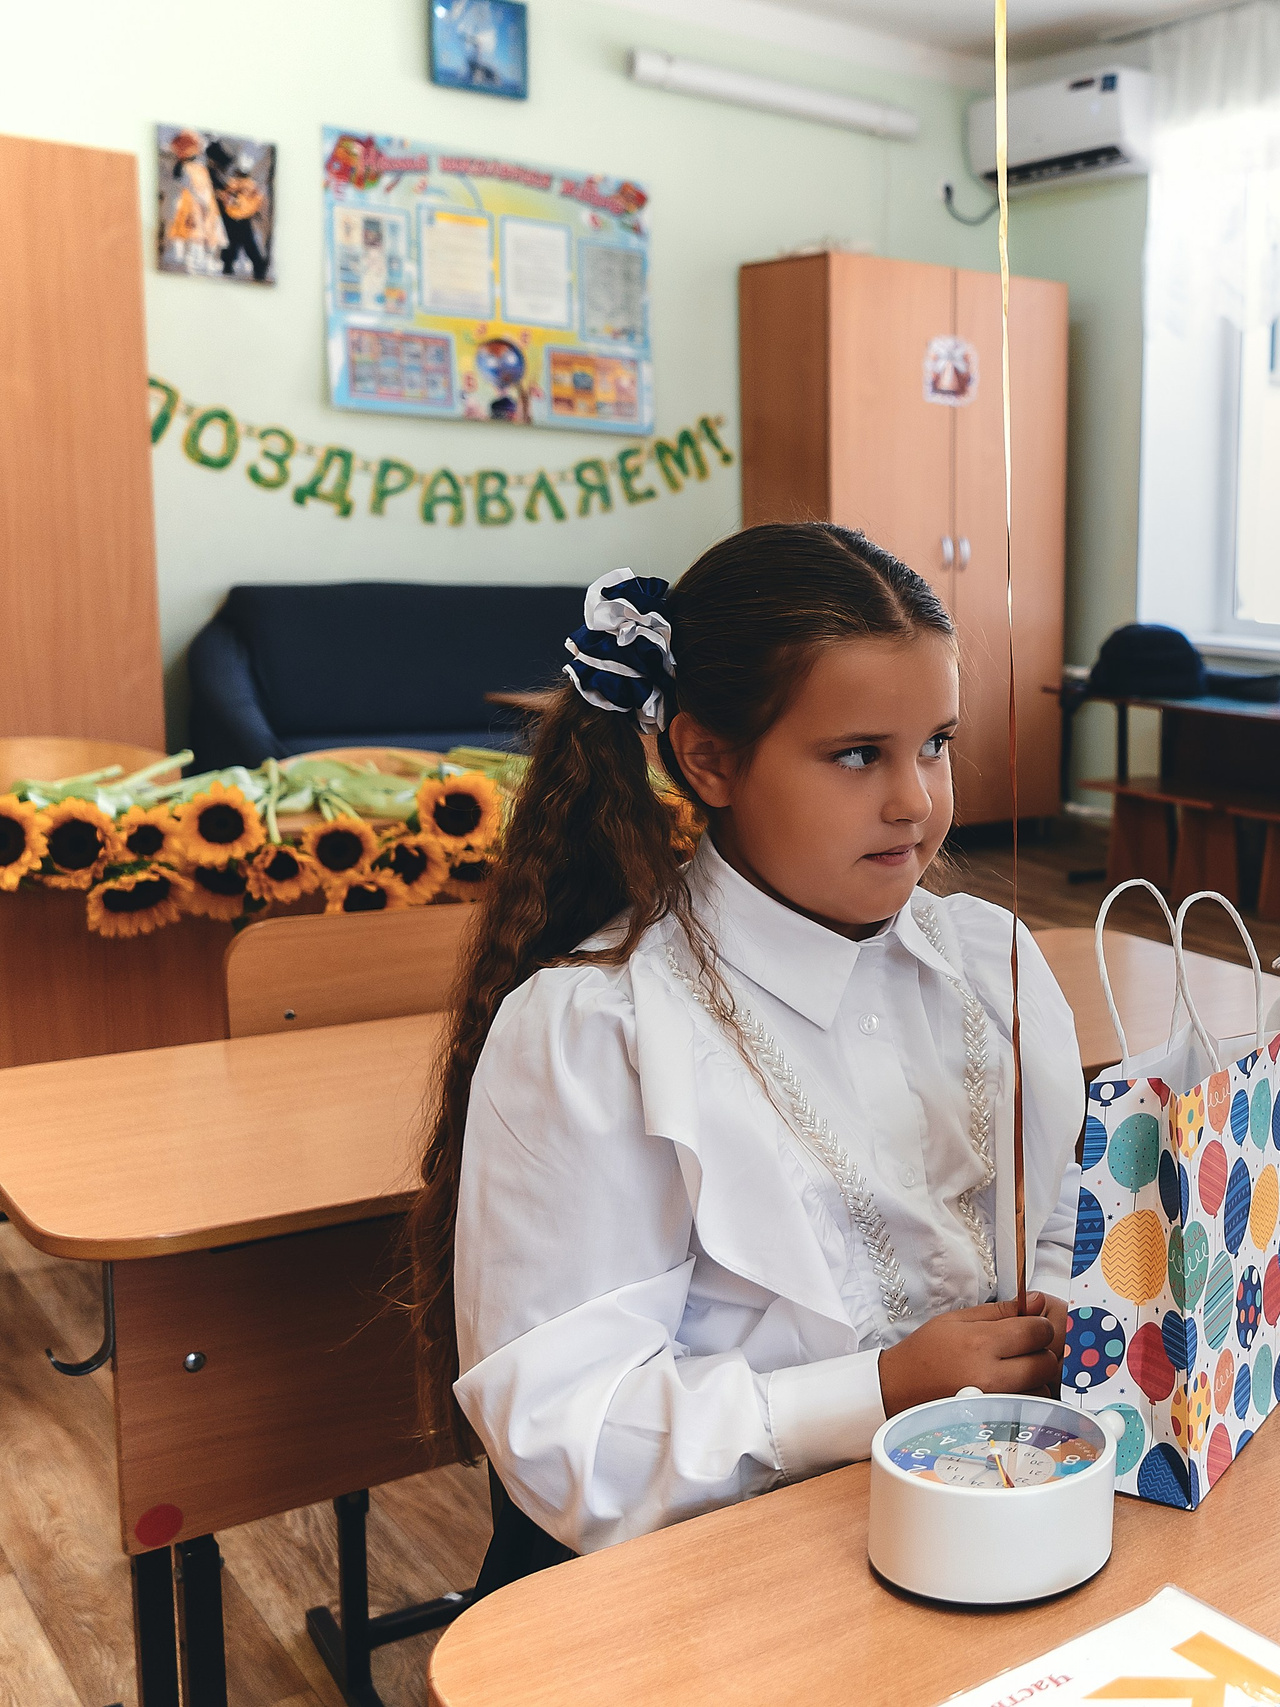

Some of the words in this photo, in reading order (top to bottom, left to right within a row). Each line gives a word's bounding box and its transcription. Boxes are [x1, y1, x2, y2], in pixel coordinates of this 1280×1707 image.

[975, 1429, 994, 1440] 5
[1015, 1431, 1033, 1442] 6
[939, 1435, 957, 1446] 4
[1045, 1440, 1062, 1451] 7
[911, 1448, 931, 1459] 3
[1062, 1454, 1081, 1465] 8
[906, 1464, 928, 1476] 2
